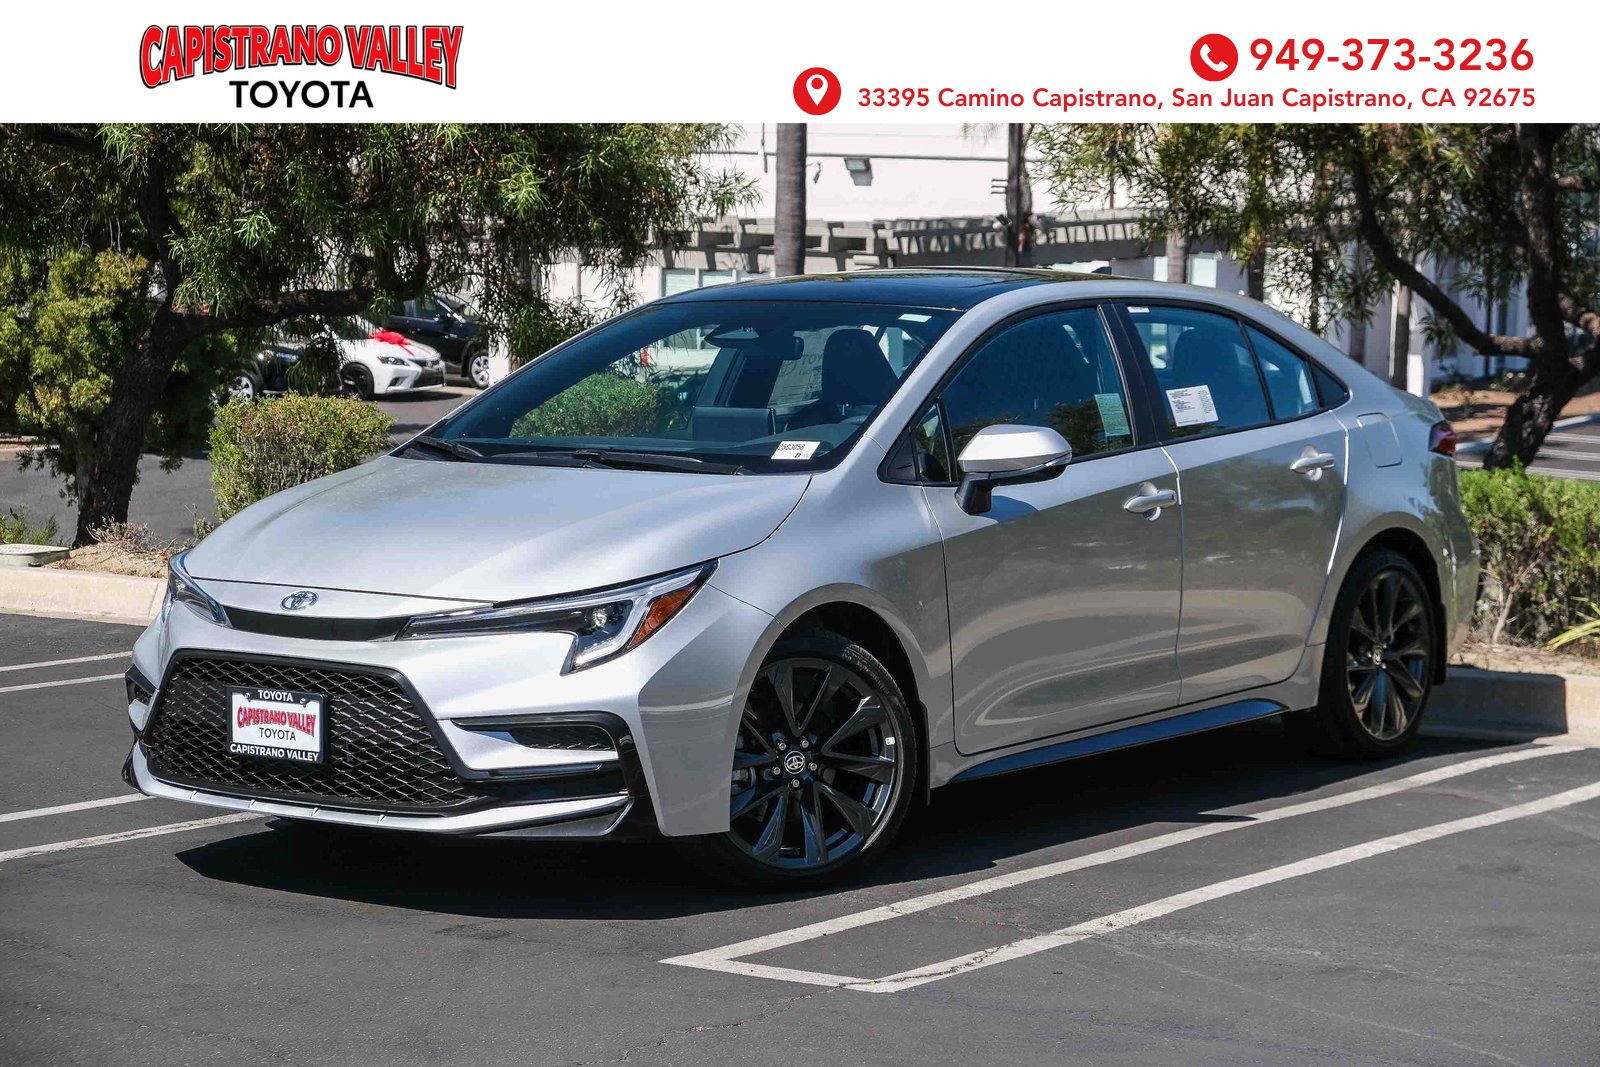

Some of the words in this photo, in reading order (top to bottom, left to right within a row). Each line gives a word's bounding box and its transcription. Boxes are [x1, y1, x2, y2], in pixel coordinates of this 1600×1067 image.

[258, 690, 293, 702] TOYOTA
[237, 706, 286, 728] CAPISTRANO
[287, 711, 316, 737] VALLEY
[259, 727, 296, 741] TOYOTA
[230, 743, 284, 757] CAPISTRANO
[287, 749, 319, 762] VALLEY
